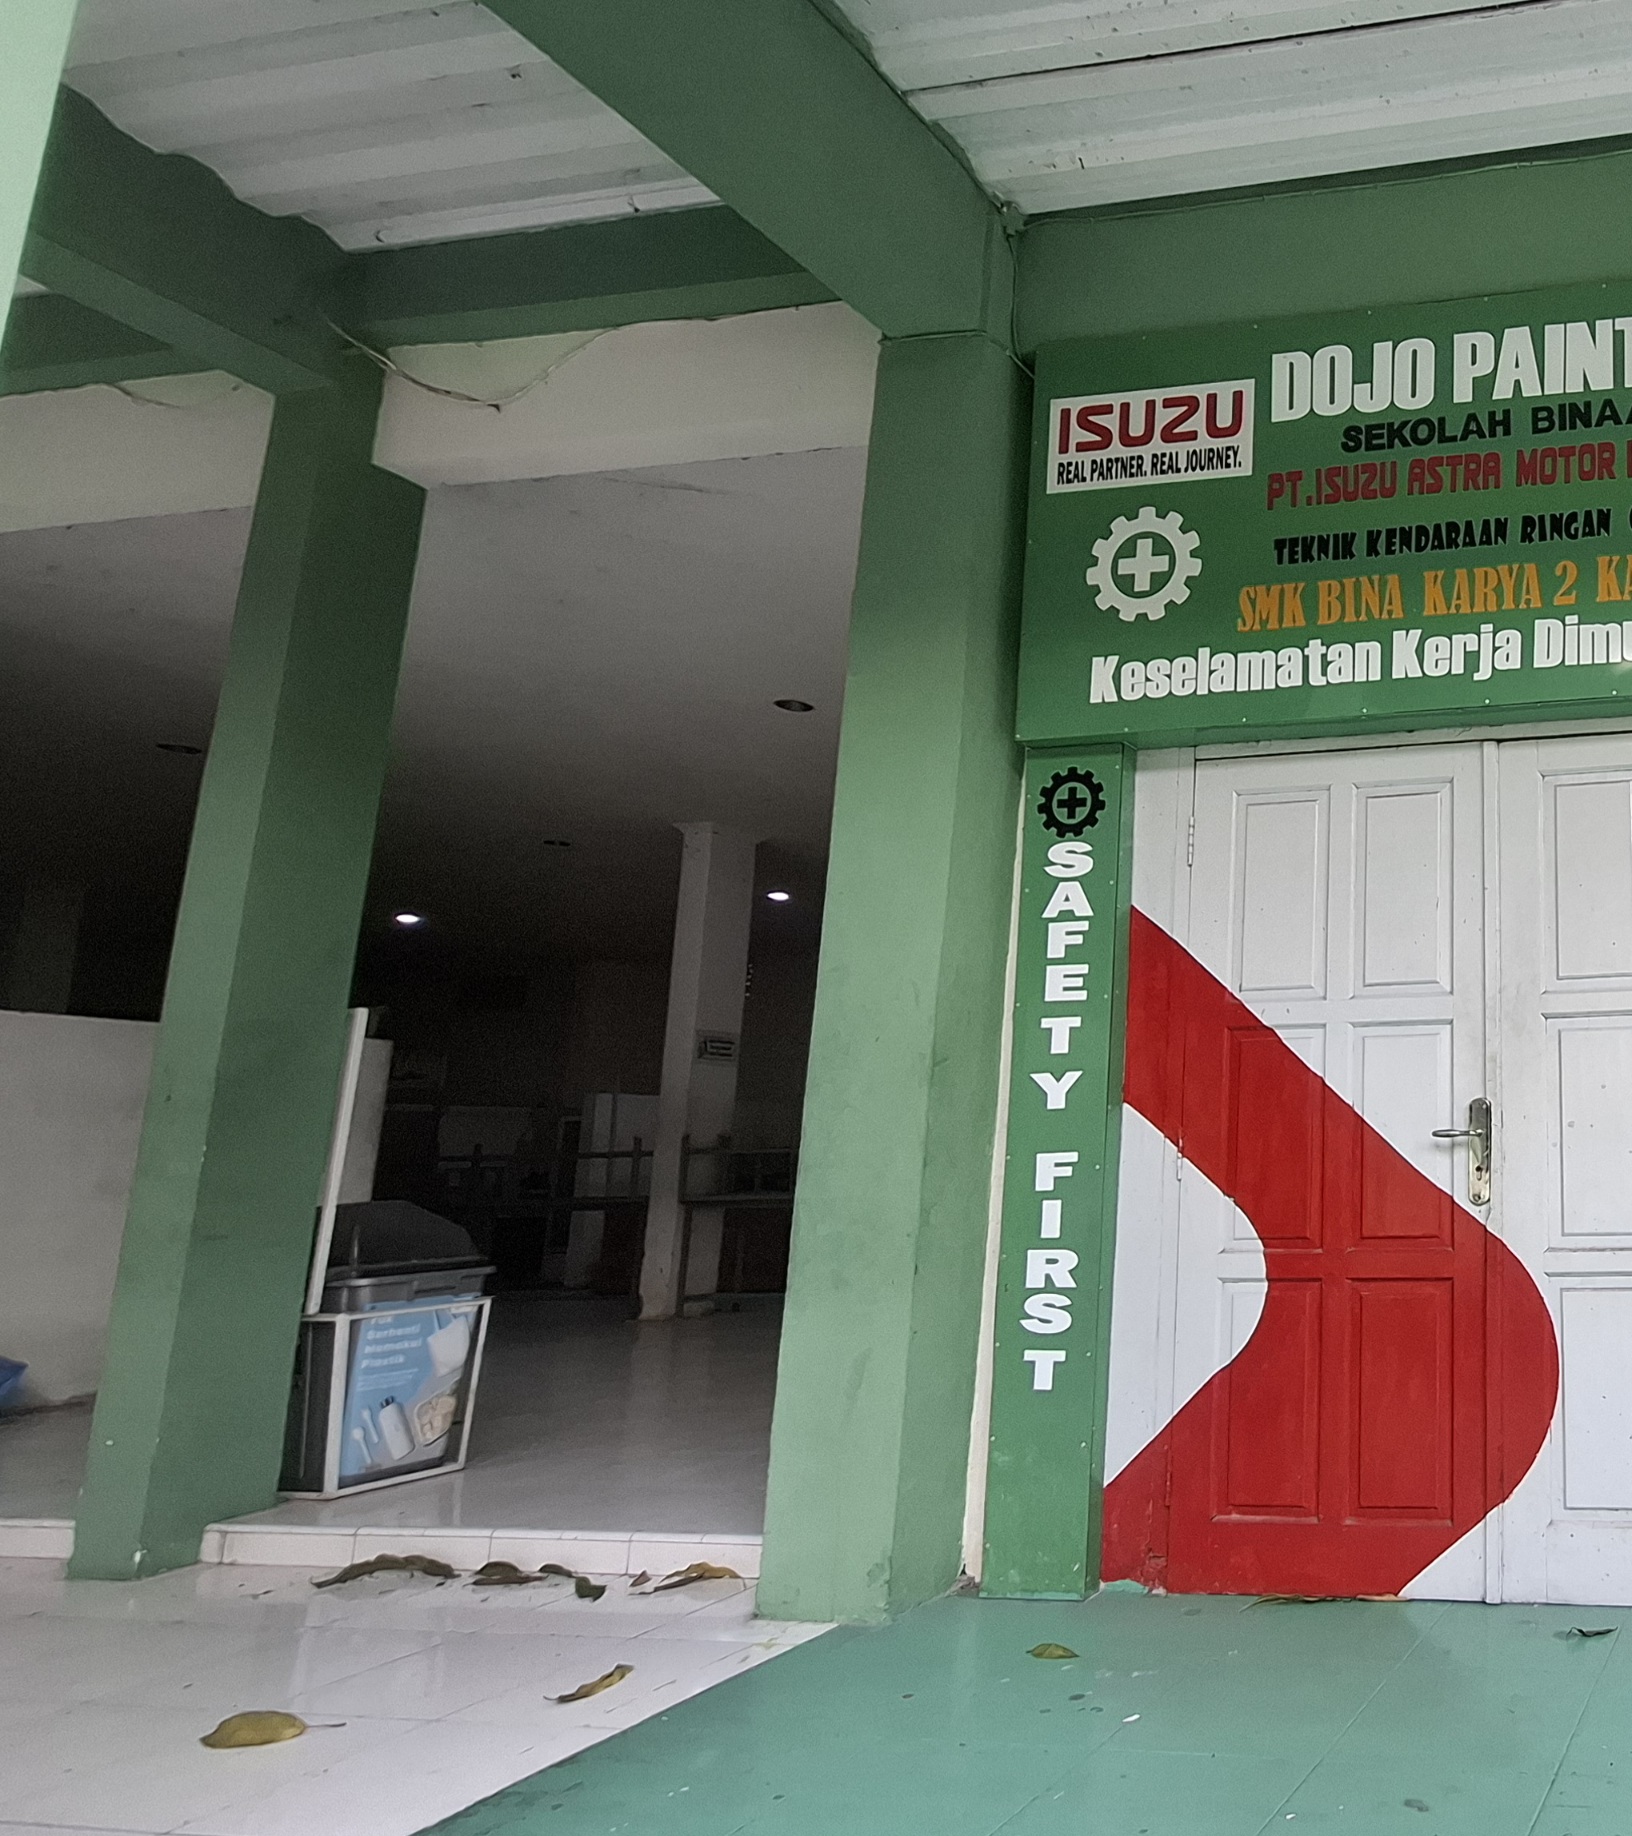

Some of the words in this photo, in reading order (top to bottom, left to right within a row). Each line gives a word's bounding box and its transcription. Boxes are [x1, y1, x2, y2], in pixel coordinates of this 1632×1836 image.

[1271, 338, 1435, 422] DOJO
[1058, 390, 1243, 454] ISUZU
[1341, 408, 1512, 453] SEKOLAH
[1057, 461, 1087, 485] REAL
[1090, 455, 1147, 482] PARTNER.
[1150, 451, 1181, 476] REAL
[1184, 445, 1242, 472] JOURNEY.
[1407, 452, 1502, 496] ASTRA
[1516, 442, 1616, 487] MOTOR
[1274, 532, 1357, 565] TEKNIK
[1366, 517, 1508, 558] KENDARAAN
[1519, 508, 1611, 544] RINGAN
[1238, 582, 1306, 632] SMK
[1317, 574, 1404, 625] BINA
[1423, 563, 1542, 616] KARYA
[1553, 560, 1578, 606] 2
[1089, 638, 1382, 703] Keselamatan
[1392, 623, 1521, 682] Kerja
[1029, 841, 1095, 1111] SAFETY
[1019, 1151, 1079, 1391] FIRST
